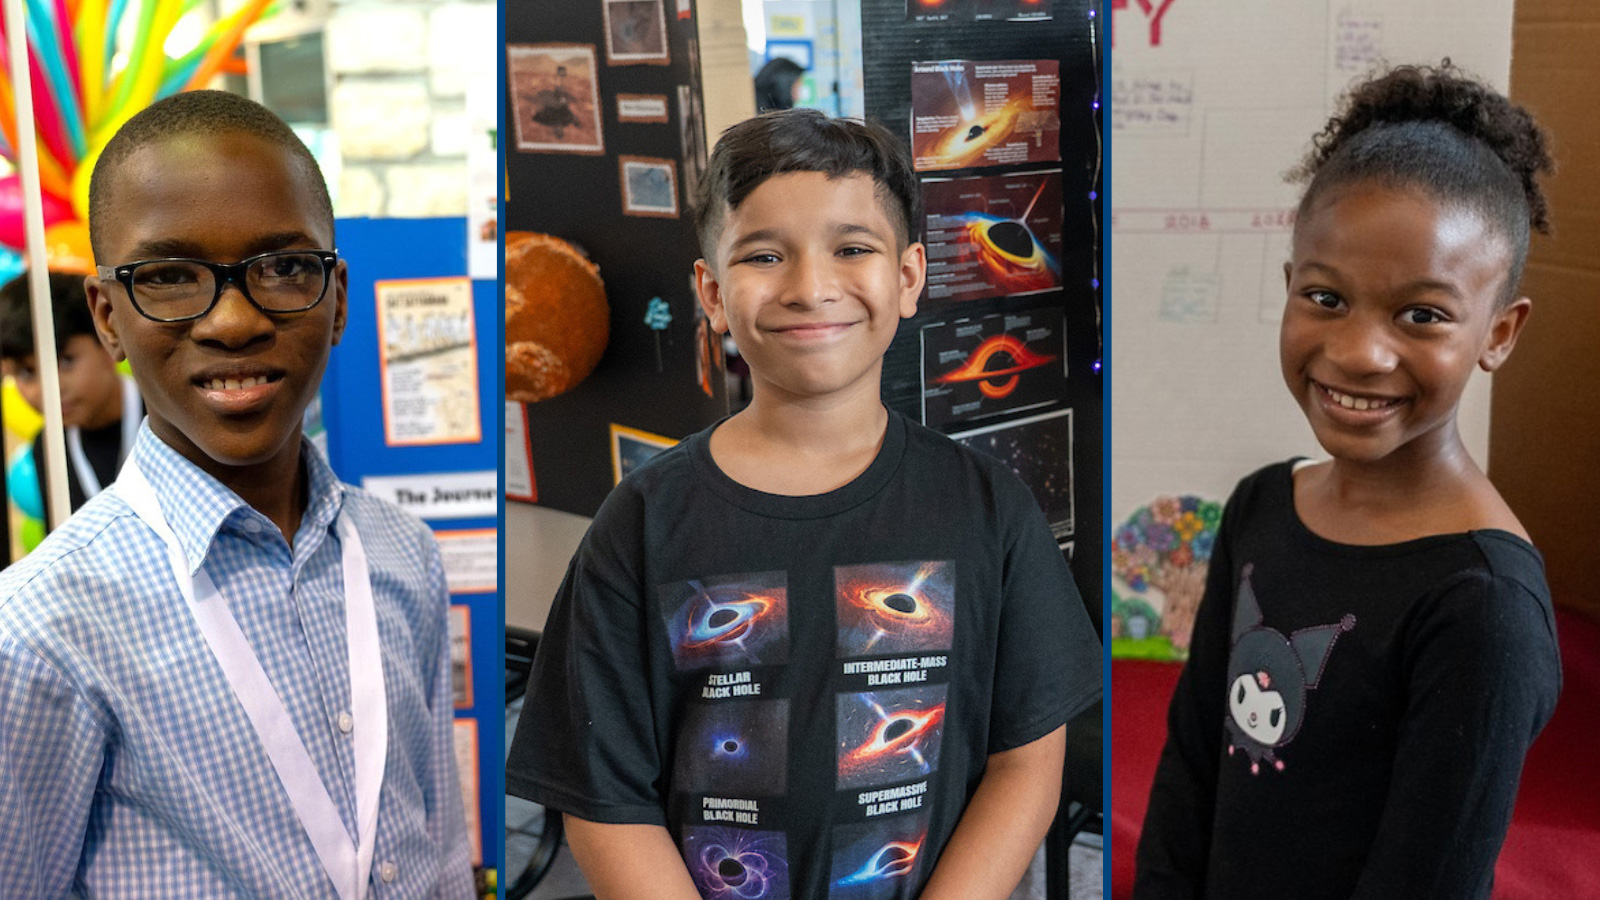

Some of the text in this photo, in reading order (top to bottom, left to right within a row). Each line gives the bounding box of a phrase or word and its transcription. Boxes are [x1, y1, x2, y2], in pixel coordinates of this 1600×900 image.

[914, 65, 934, 73] Around
[935, 65, 949, 73] Black
[395, 487, 497, 503] The Journe
[843, 656, 947, 674] INTERMEDIATE-MASS
[708, 671, 751, 685] STELLAR
[868, 670, 927, 685] BLACK HOLE
[732, 683, 761, 696] HOLE
[858, 782, 927, 804] SUPERMASSIVE
[703, 797, 759, 811] PRIMORDIAL
[866, 796, 922, 816] BLACK HOLE
[703, 810, 758, 824] BLACK HOLE
